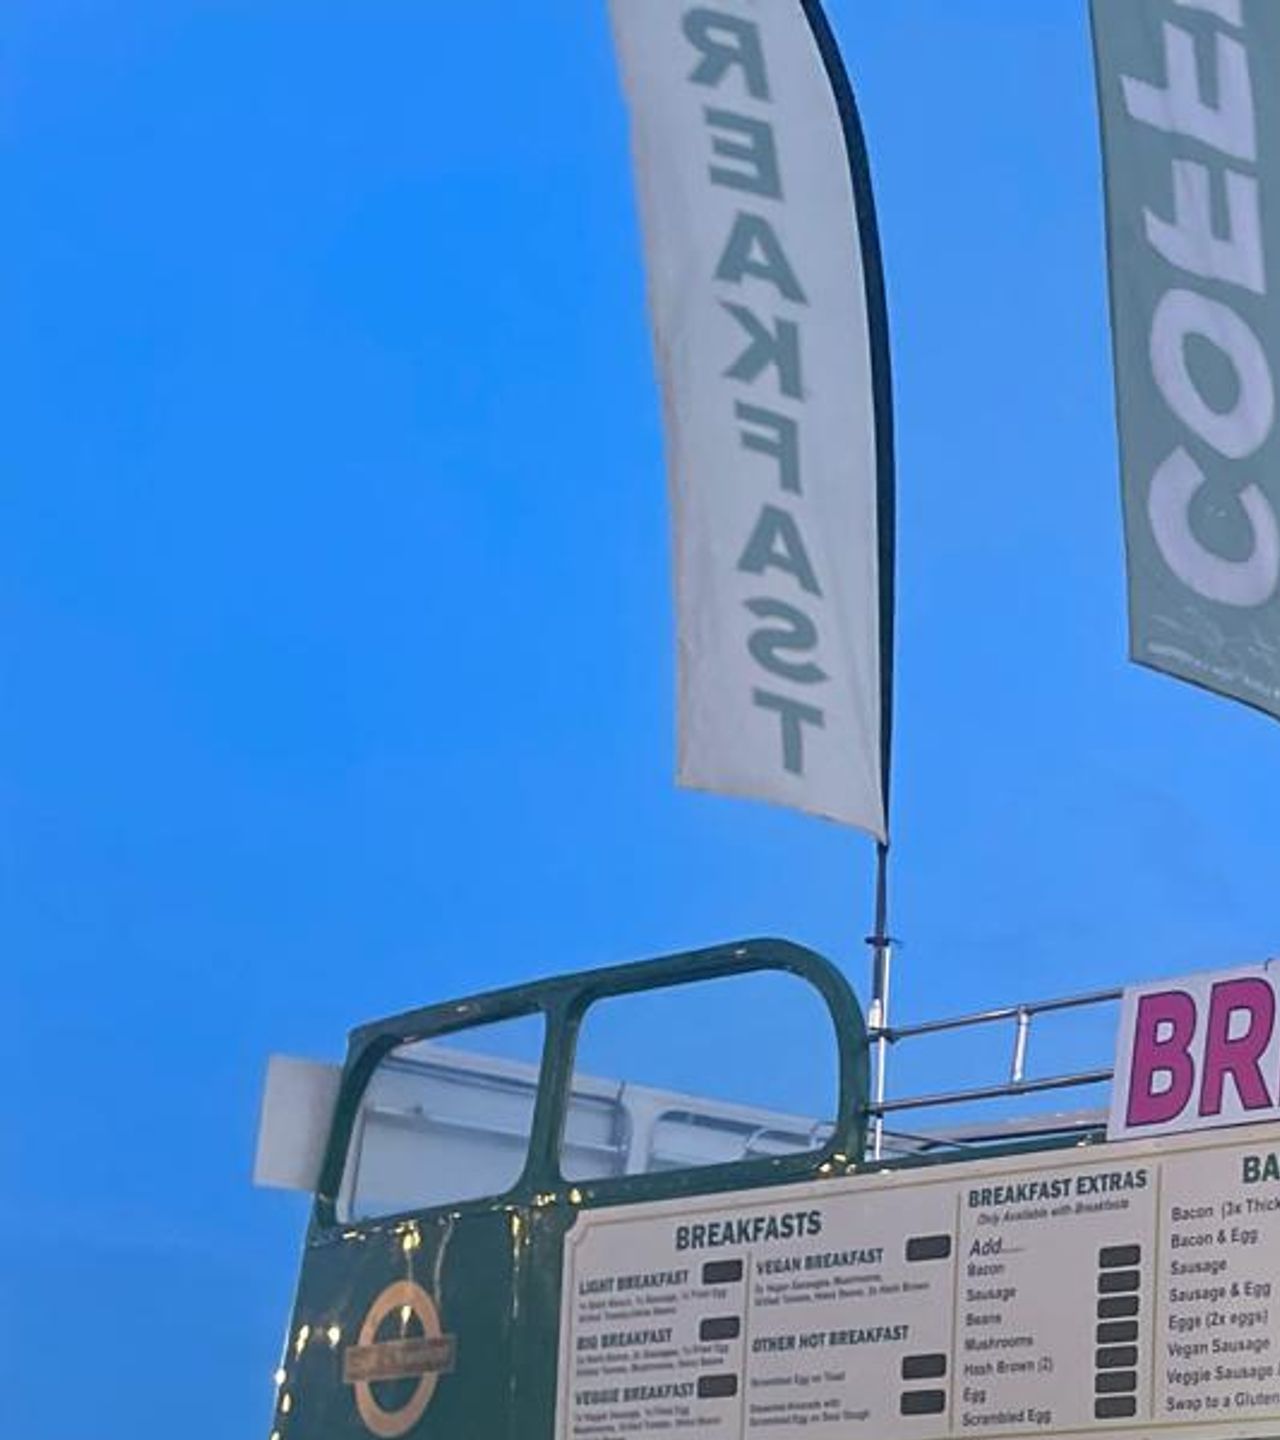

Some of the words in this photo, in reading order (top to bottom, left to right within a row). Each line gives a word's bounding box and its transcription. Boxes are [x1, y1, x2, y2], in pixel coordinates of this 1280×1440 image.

[968, 1178, 1073, 1209] BREAKFAST
[1076, 1169, 1148, 1196] EXTRAS
[1171, 1206, 1214, 1222] Bacon
[675, 1210, 822, 1250] BREAKFASTS
[1170, 1233, 1214, 1249] Bacon
[1216, 1231, 1227, 1243] &
[1231, 1227, 1259, 1245] Egg
[756, 1255, 801, 1276] VEGAN
[804, 1248, 885, 1271] BREAKFAST
[967, 1264, 1004, 1277] Bacon
[1170, 1259, 1227, 1277] Sausage
[617, 1269, 690, 1293] BREAKFAST
[967, 1287, 1017, 1302] Sausage
[1169, 1285, 1226, 1303] Sausage
[1229, 1282, 1240, 1297] &
[1244, 1281, 1271, 1298] Egg
[966, 1313, 1002, 1327] Beans
[601, 1328, 673, 1349] BREAKFAST
[752, 1336, 796, 1353] OTHER
[800, 1332, 826, 1349] HOT
[829, 1325, 910, 1346] BREAKFAST
[965, 1336, 1034, 1351] Mushrooms
[1167, 1342, 1209, 1359] Vegan
[1212, 1336, 1271, 1354] Sausage
[964, 1361, 994, 1377] Hash
[996, 1360, 1035, 1374] Brown
[1167, 1368, 1211, 1387] Veggie
[1214, 1363, 1274, 1381] Sausage
[623, 1382, 695, 1402] BREAKFAST
[963, 1387, 987, 1404] Egg
[1166, 1396, 1202, 1412] Swap
[1205, 1395, 1219, 1409] to
[1234, 1391, 1280, 1407] Gluten
[1027, 1408, 1052, 1425] Egg
